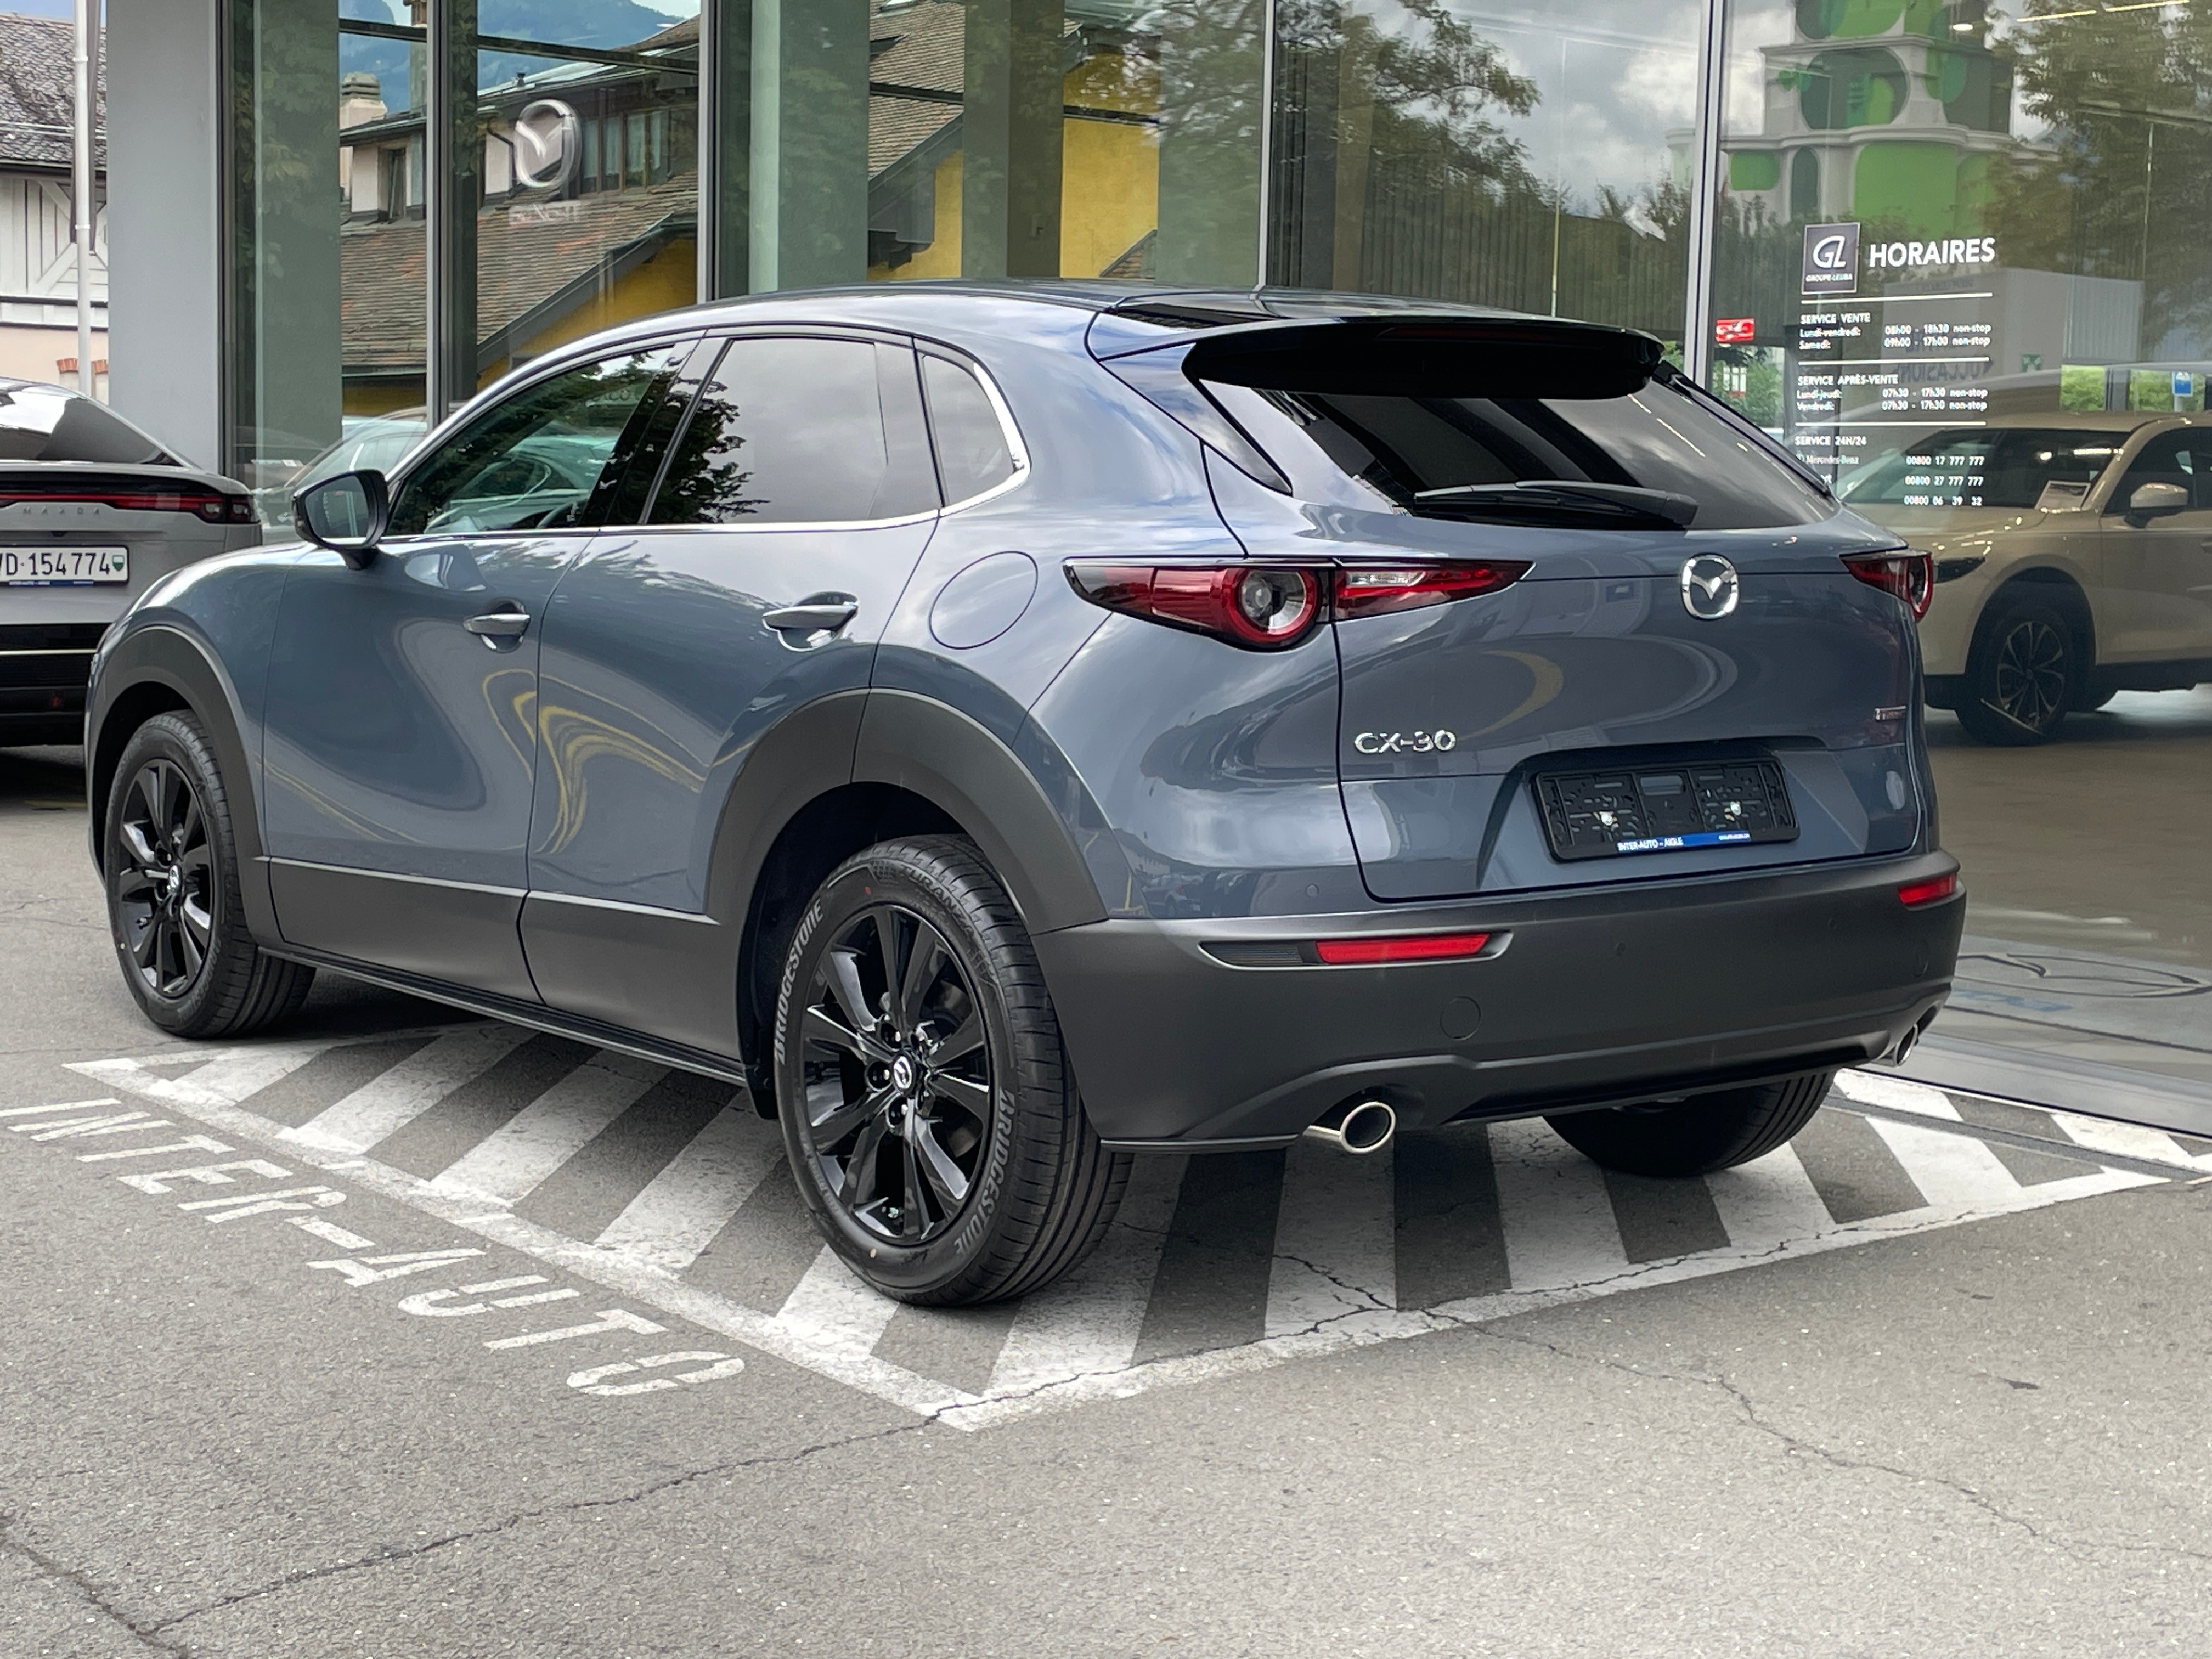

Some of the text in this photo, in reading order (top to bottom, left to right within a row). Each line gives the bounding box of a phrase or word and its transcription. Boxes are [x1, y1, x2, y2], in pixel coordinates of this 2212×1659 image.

[1870, 238, 1995, 267] HORAIRES
[1801, 313, 1870, 324] SERVICE VENTE
[1885, 325, 1911, 335] 08h00
[1924, 324, 1949, 334] 18h30
[1953, 324, 1991, 334] non-stop
[1884, 337, 1910, 347] 09h00
[1923, 336, 1948, 346] 17h00
[1953, 337, 1990, 347] non-stop
[1798, 374, 1898, 386] SERVICE APRÈS-VENTE
[1883, 388, 1909, 397] 07h30
[1921, 387, 1945, 397] 17h30
[1950, 388, 1988, 399] non-stop
[1882, 400, 1908, 410] 07h30
[1921, 400, 1945, 409] 17h30
[1949, 401, 1987, 411] non-stop
[1795, 436, 1866, 445] SERVICE 24H/24
[1906, 456, 1931, 465] 00800
[1936, 456, 1945, 465] 17
[1950, 456, 1965, 465] 777
[1969, 456, 1984, 465] 777
[1905, 476, 1983, 486] 00800 27 777 777
[1904, 496, 1982, 506] 00800 06 39 32
[1355, 730, 1455, 753] CX-30
[774, 898, 823, 1065] BRIDGESTONE
[954, 1086, 1014, 1254] BRIDGESTONE
